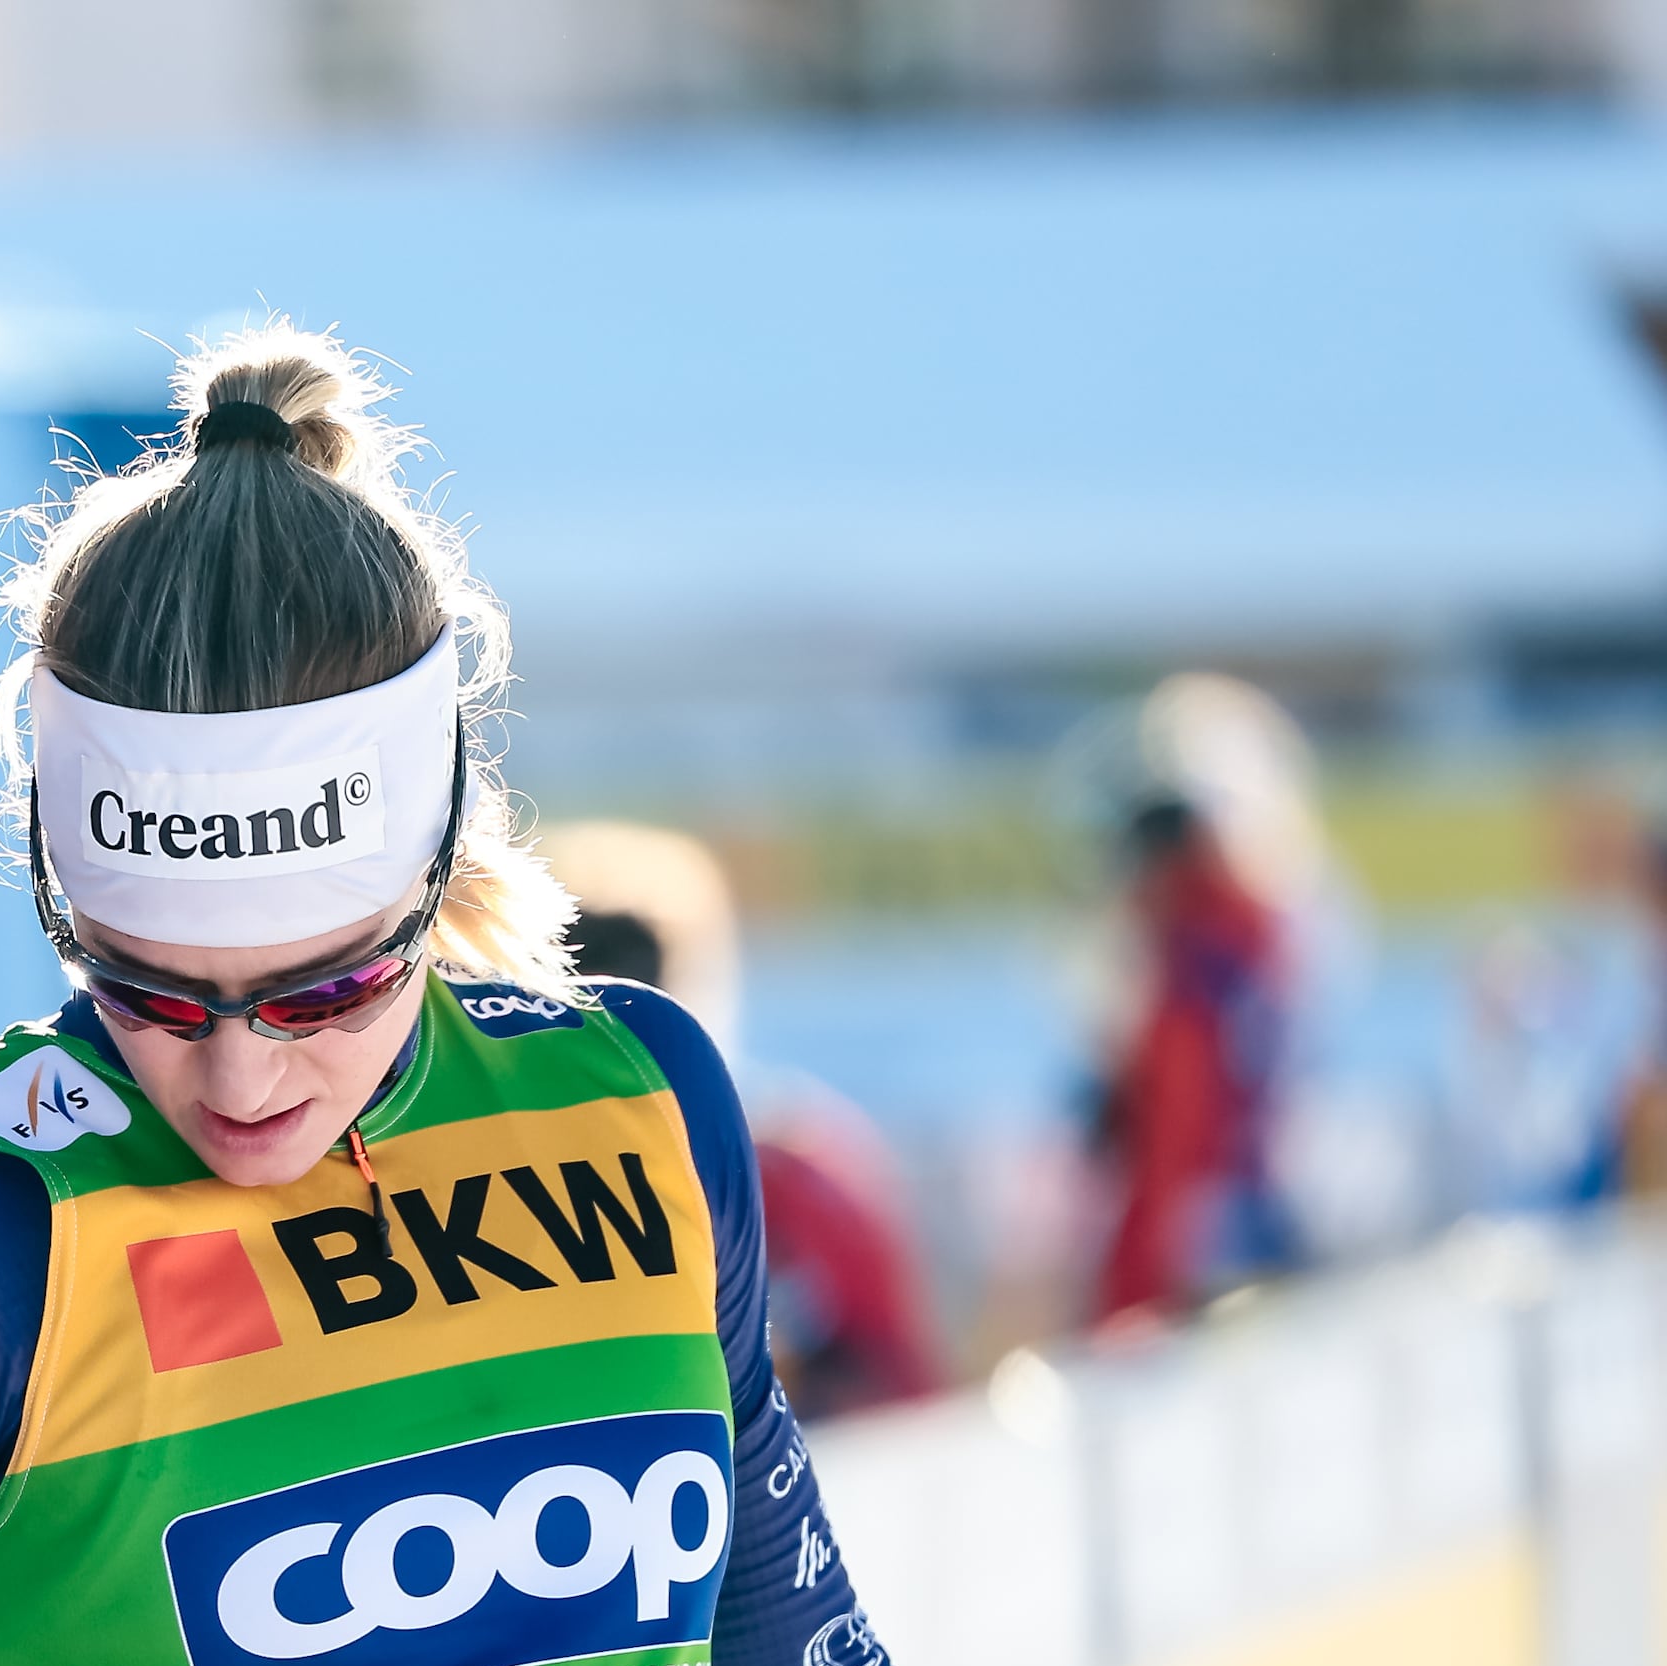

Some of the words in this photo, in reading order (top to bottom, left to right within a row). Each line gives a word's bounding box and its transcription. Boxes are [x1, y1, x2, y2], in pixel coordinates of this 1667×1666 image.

[10, 1086, 90, 1139] FIS
[271, 1151, 678, 1336] BKW
[217, 1450, 730, 1660] coop
